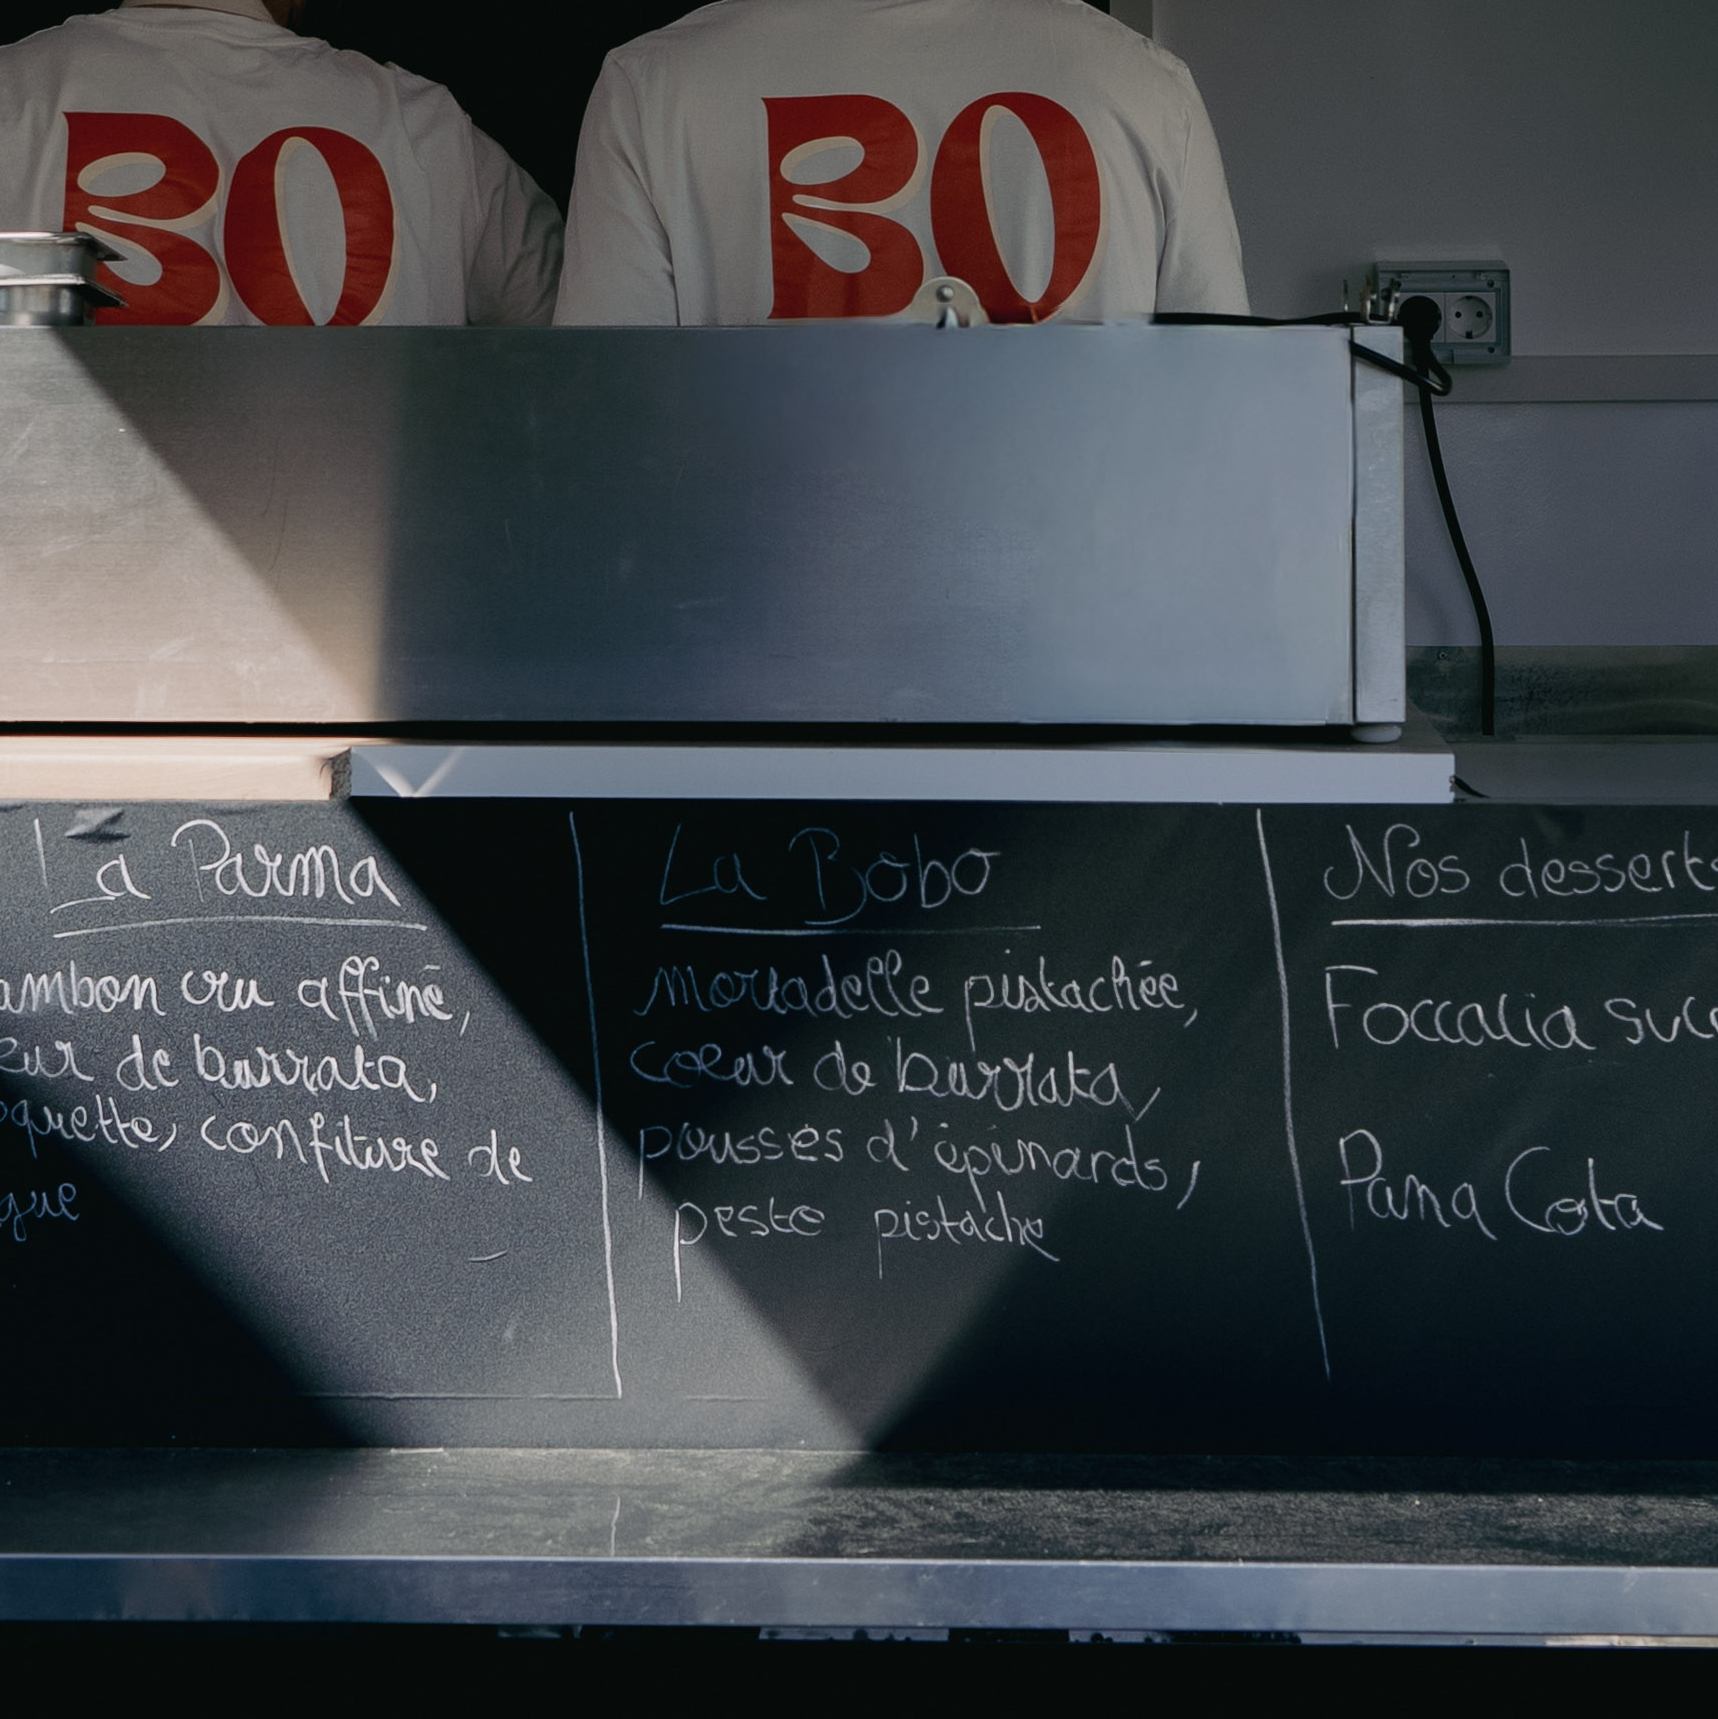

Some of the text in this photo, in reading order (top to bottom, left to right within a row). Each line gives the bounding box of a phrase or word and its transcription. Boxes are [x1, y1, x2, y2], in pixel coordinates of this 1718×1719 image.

[61, 111, 399, 326] BO
[760, 91, 1109, 325] BO
[35, 819, 401, 913] La Parma
[661, 822, 1001, 926] La Bobo
[1323, 823, 1469, 900] Nos
[182, 970, 274, 1010] cru
[117, 1034, 179, 1091] de
[814, 1040, 877, 1095] de
[201, 1113, 450, 1183] confiture
[469, 1129, 533, 1183] de
[639, 1122, 843, 1201] pousses
[1339, 1129, 1664, 1240] Pana Cota
[875, 1191, 1060, 1280] pistache
